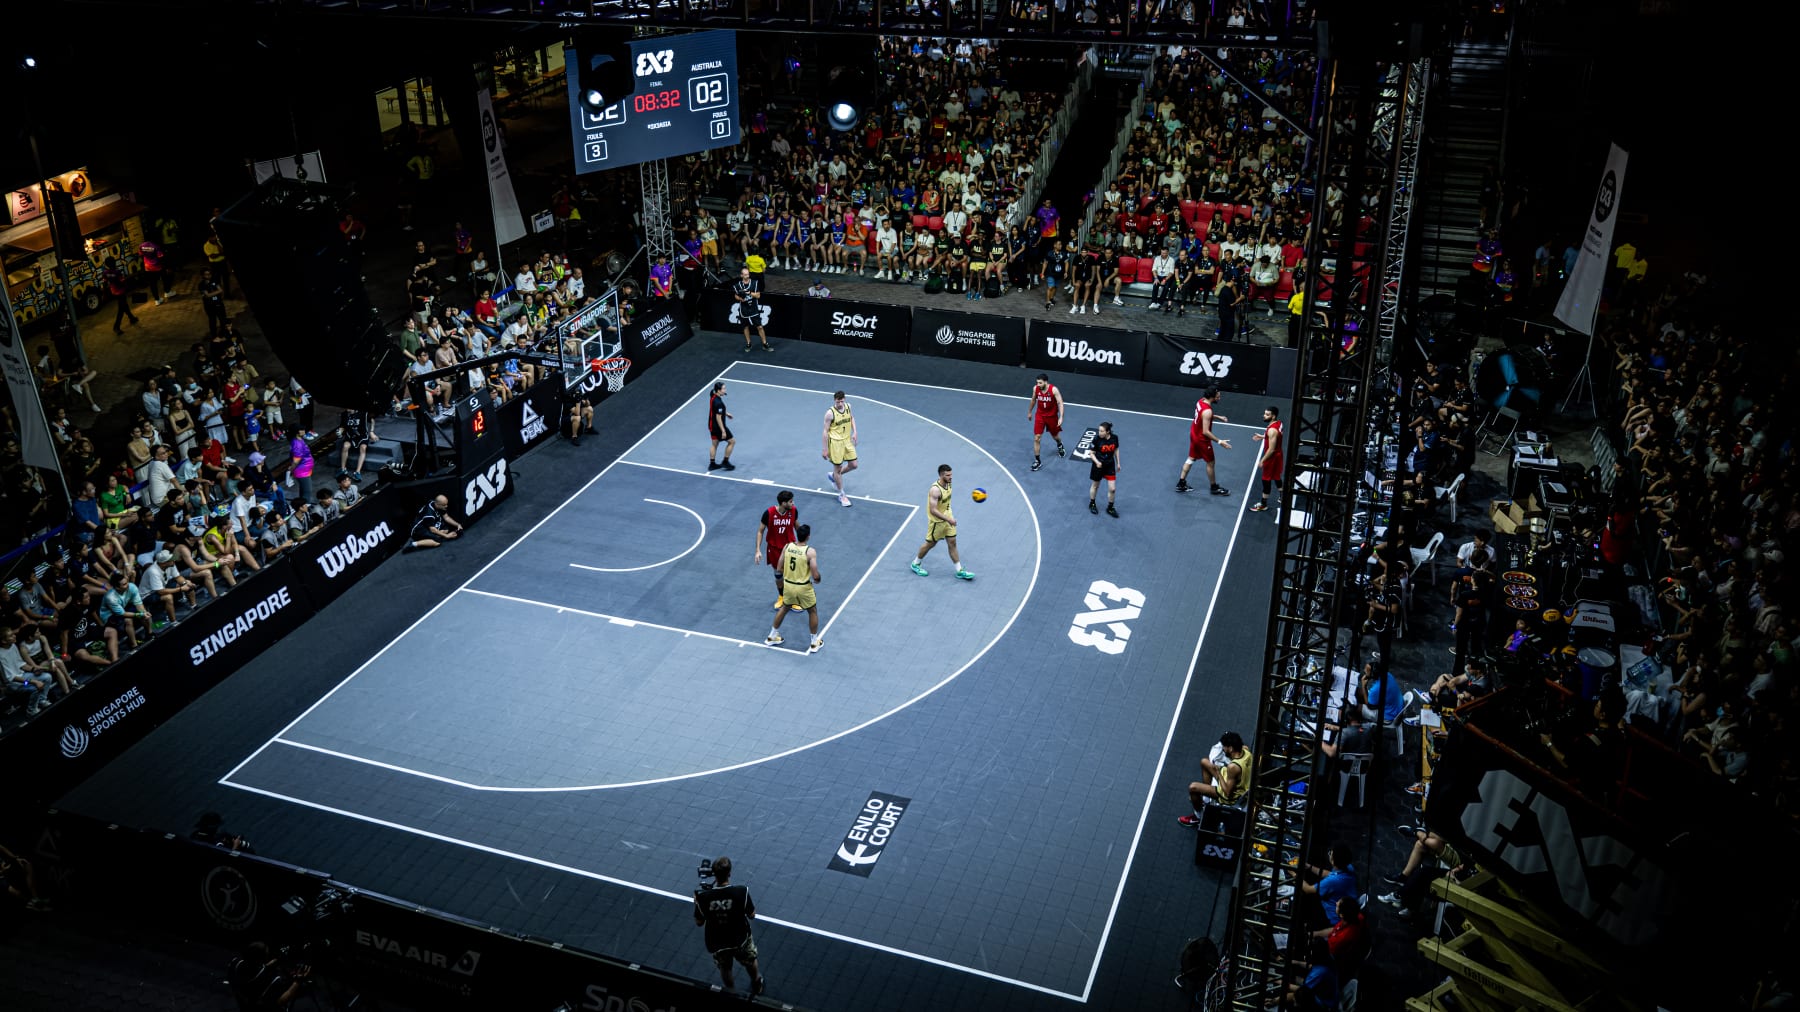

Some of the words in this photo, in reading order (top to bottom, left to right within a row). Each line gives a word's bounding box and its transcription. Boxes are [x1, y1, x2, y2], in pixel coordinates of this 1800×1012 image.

[691, 60, 722, 72] AUSTRALIA
[695, 79, 722, 104] 02
[633, 89, 681, 113] 08:32
[713, 111, 728, 119] FOULS
[586, 132, 604, 141] FOULS
[716, 122, 725, 135] 0
[591, 144, 601, 158] 3
[833, 328, 874, 339] SINGAPORE
[957, 329, 996, 340] SINGAPORE
[956, 336, 980, 346] SPORTS
[982, 338, 996, 348] HUB
[1046, 336, 1124, 366] Wilson
[520, 416, 548, 444] PEAK
[773, 518, 791, 526] IRAN
[778, 526, 786, 534] 17
[316, 521, 394, 578] Wilson
[789, 556, 797, 572] 5
[189, 584, 292, 667] SINGAPORE
[87, 686, 140, 727] SINGAPORE
[91, 708, 127, 738] SPORTS
[126, 694, 147, 714] HUB
[847, 798, 885, 842] ENLIO
[868, 802, 904, 846] COURT
